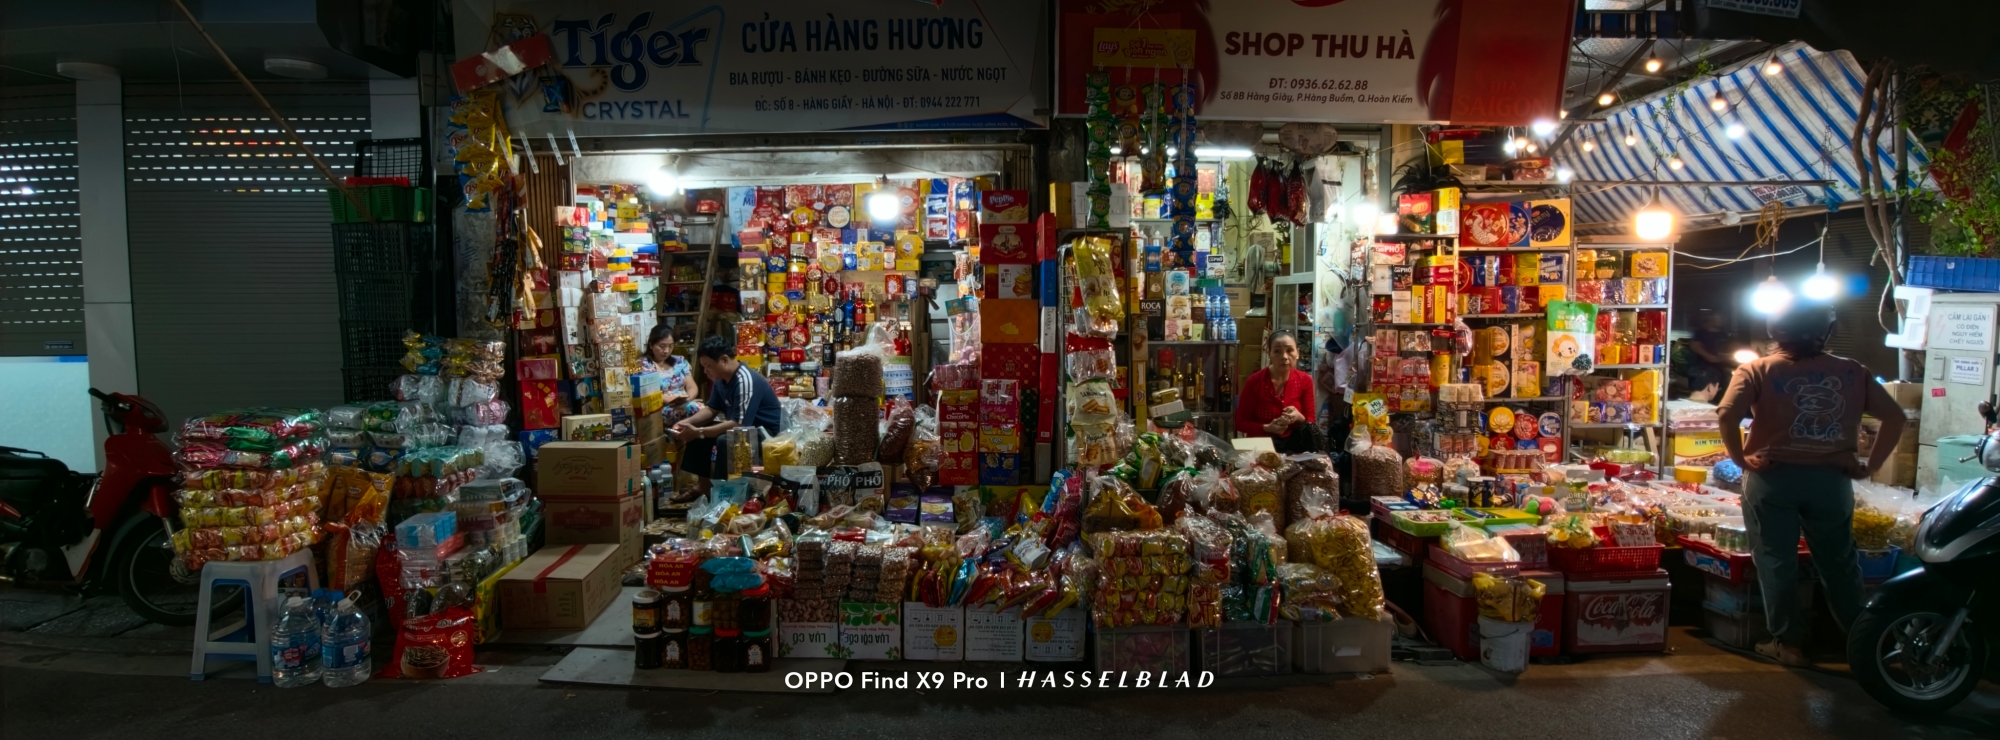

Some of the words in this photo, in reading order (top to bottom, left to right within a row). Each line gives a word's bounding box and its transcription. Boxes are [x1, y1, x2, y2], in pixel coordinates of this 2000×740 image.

[741, 11, 797, 53] CỬA
[805, 12, 879, 52] HÀNG
[887, 17, 984, 51] HƯƠNG
[552, 10, 710, 92] Tiger
[1224, 31, 1305, 57] SHOP
[1311, 33, 1369, 58] THU
[1375, 29, 1416, 60] HÀ
[729, 71, 749, 86] BIA
[751, 69, 785, 87] RƯỢU
[794, 67, 827, 84] BÁNH
[828, 69, 852, 87] KẸO
[862, 66, 904, 83] ĐƯỜNG
[906, 64, 931, 82] SỮA
[941, 65, 974, 82] NƯỚC
[977, 66, 1008, 84] NGỌT
[1268, 77, 1288, 89] ĐT:
[1290, 77, 1369, 91] 0936.62.62.88
[773, 96, 787, 111] SỐ
[788, 100, 794, 110] 8
[803, 96, 829, 111] HÀNG
[861, 95, 876, 109] HÀ
[876, 94, 894, 110] NỘI
[920, 96, 943, 109] 0944
[944, 96, 962, 108] 222
[962, 96, 981, 108] 771
[1220, 90, 1232, 100] Số
[1233, 92, 1245, 100] 8B
[1246, 92, 1270, 103] Hàng
[1296, 93, 1327, 104] P.Hàng
[1357, 93, 1390, 104] Q.Hoàn
[1391, 93, 1413, 104] Kiếm
[582, 100, 690, 120] CRYSTAL
[742, 196, 757, 207] Mil
[1947, 311, 1961, 321] CẤM
[808, 631, 826, 644] LỤA
[860, 632, 873, 645] CỘI
[875, 633, 890, 644] LỤA
